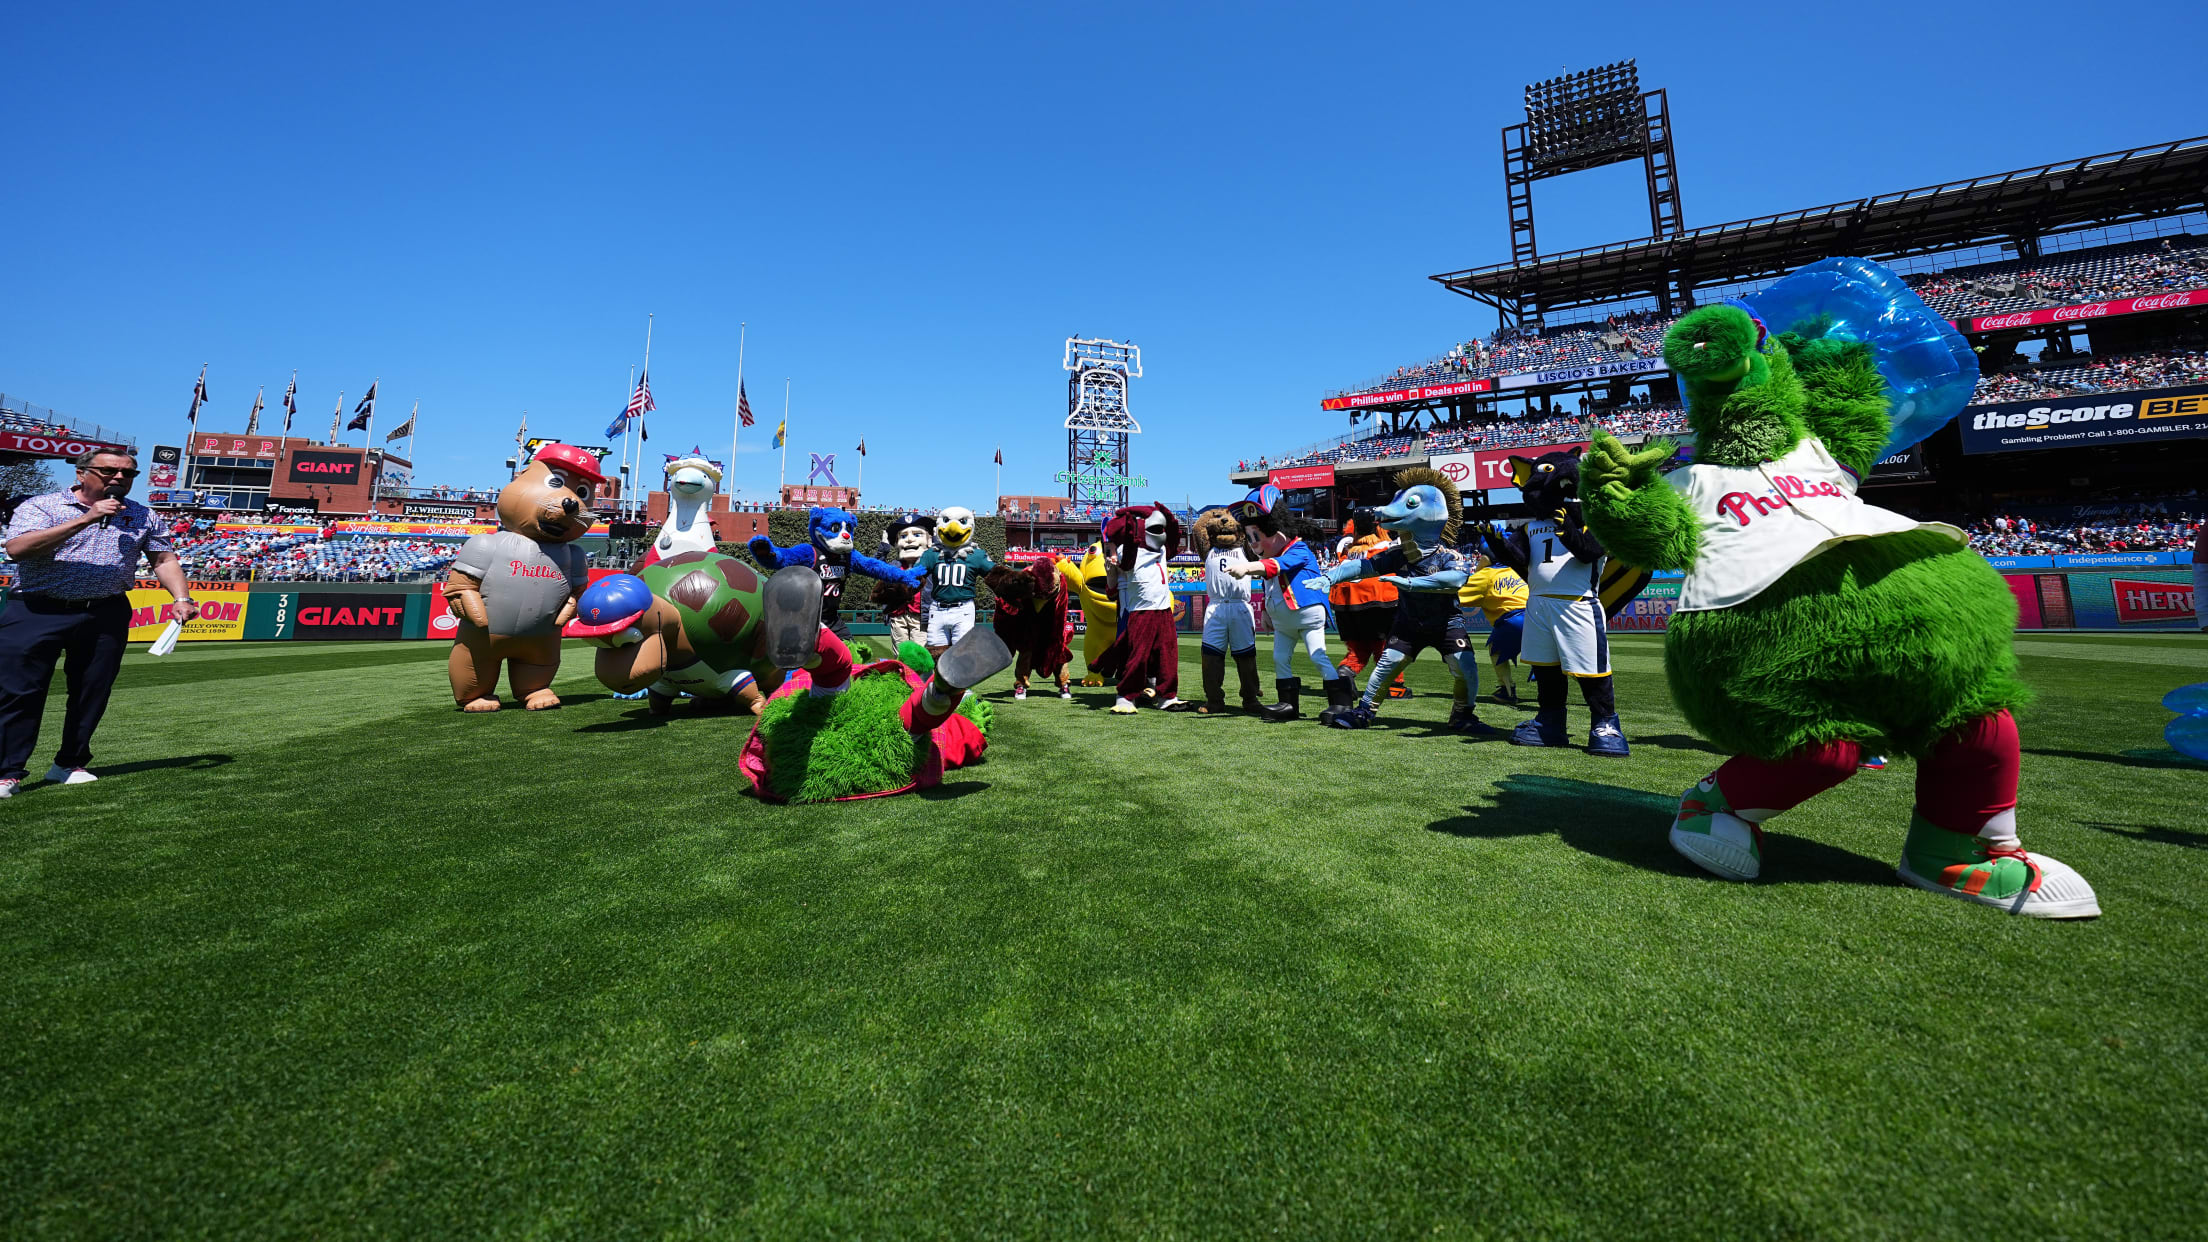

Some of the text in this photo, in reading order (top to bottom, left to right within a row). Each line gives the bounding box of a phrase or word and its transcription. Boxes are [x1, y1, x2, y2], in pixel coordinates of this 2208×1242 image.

[1536, 360, 1657, 383] LISCIO'S BAKERY
[1425, 382, 1483, 397] Deals roll in
[1350, 393, 1403, 406] Phillies win
[1973, 403, 2133, 431] theScore
[11, 435, 111, 456] TOYOT
[2001, 436, 2043, 445] Gambling
[2043, 432, 2085, 442] Problem?
[296, 461, 355, 474] GIANT
[1057, 470, 1147, 487] Citizens Bank
[1088, 487, 1116, 500] Park
[279, 505, 314, 514] Fanatics
[345, 522, 388, 535] Surfside
[425, 525, 466, 537] Surfside
[1542, 538, 1554, 563] 1
[2068, 554, 2143, 566] Independence
[509, 560, 562, 581] Phillies
[937, 563, 967, 587] 00
[823, 582, 840, 597] 76
[298, 606, 403, 626] GIANT
